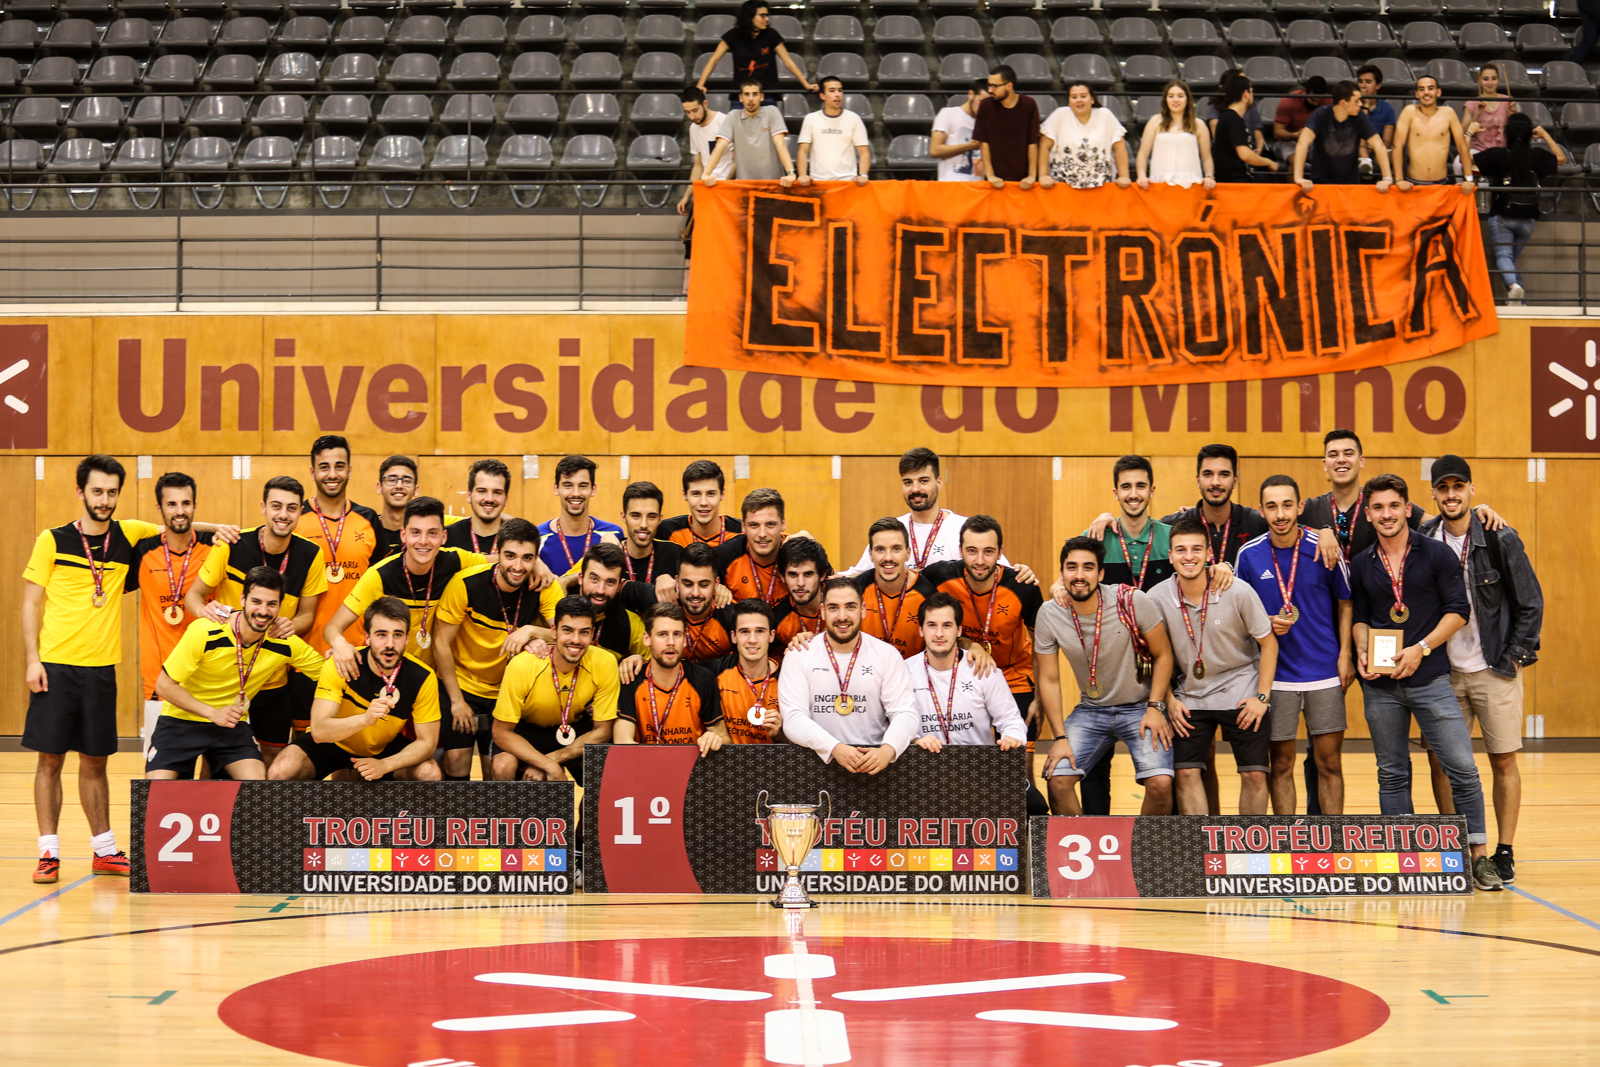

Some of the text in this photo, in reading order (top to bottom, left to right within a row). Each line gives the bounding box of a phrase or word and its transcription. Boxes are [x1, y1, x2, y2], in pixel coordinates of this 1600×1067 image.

[118, 338, 876, 434] Universidade
[158, 812, 221, 862] 2º
[303, 810, 567, 845] TROFÉU REITOR
[614, 796, 671, 845] 1º
[898, 818, 1018, 846] REITOR
[1201, 819, 1462, 851] TROFÉU REITOR
[1058, 834, 1121, 880] 3º
[303, 875, 568, 892] UNIVERSIDADE DO MINHO
[914, 875, 943, 892] DO
[951, 875, 1019, 892] MINHO
[1205, 875, 1467, 894] UNIVERSIDADE DO MINHO
